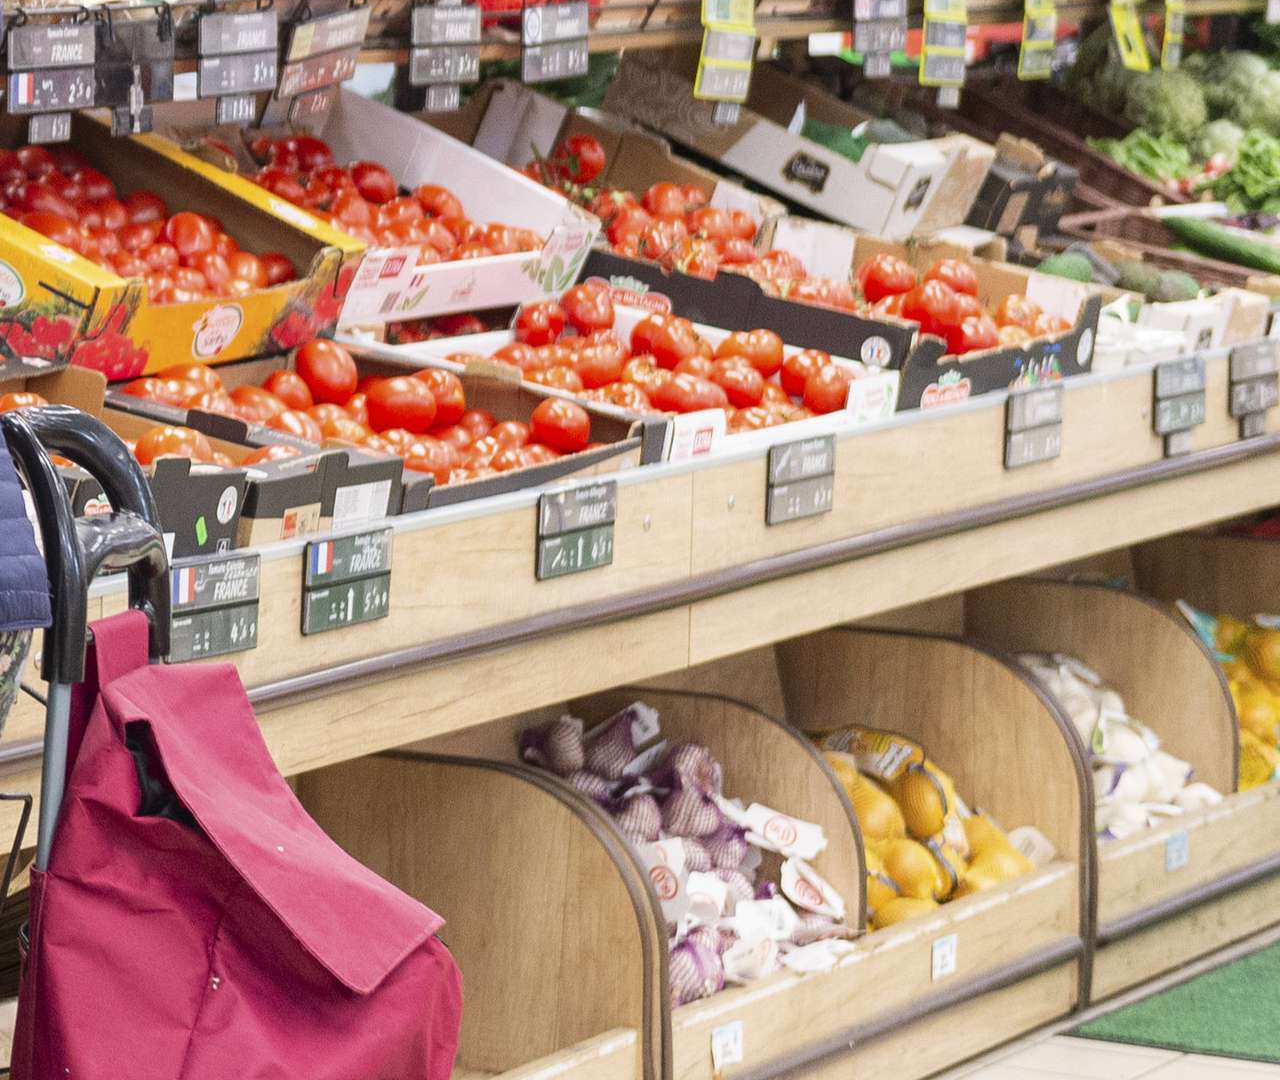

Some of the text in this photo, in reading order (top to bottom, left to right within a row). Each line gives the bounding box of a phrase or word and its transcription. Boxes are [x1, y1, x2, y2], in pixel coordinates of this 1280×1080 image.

[51, 43, 83, 62] FRANCE
[348, 550, 382, 573] FRANCE
[213, 577, 248, 601] FRANCE
